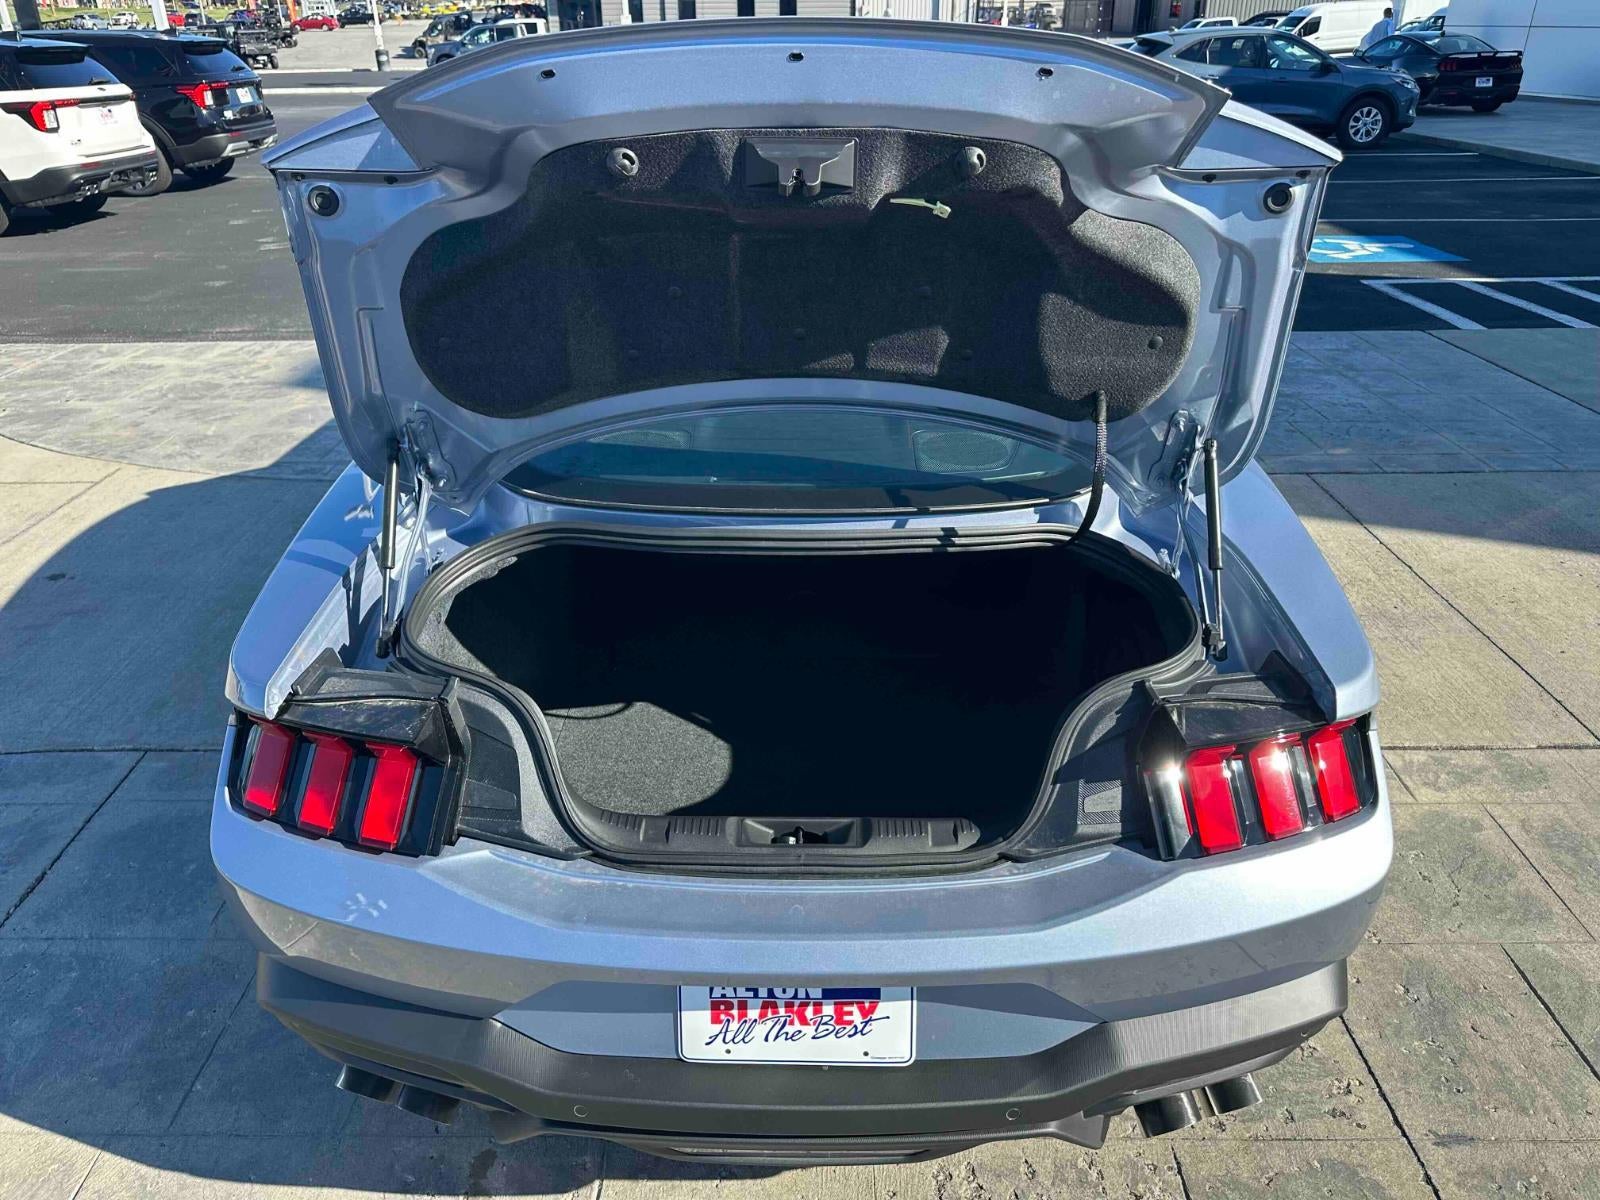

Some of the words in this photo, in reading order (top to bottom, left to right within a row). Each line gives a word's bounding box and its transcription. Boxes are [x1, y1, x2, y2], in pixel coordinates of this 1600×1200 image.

[710, 1000, 879, 1026] BLAKLEY
[704, 1017, 758, 1045] All
[760, 1014, 807, 1043] The
[809, 1014, 890, 1040] Best
